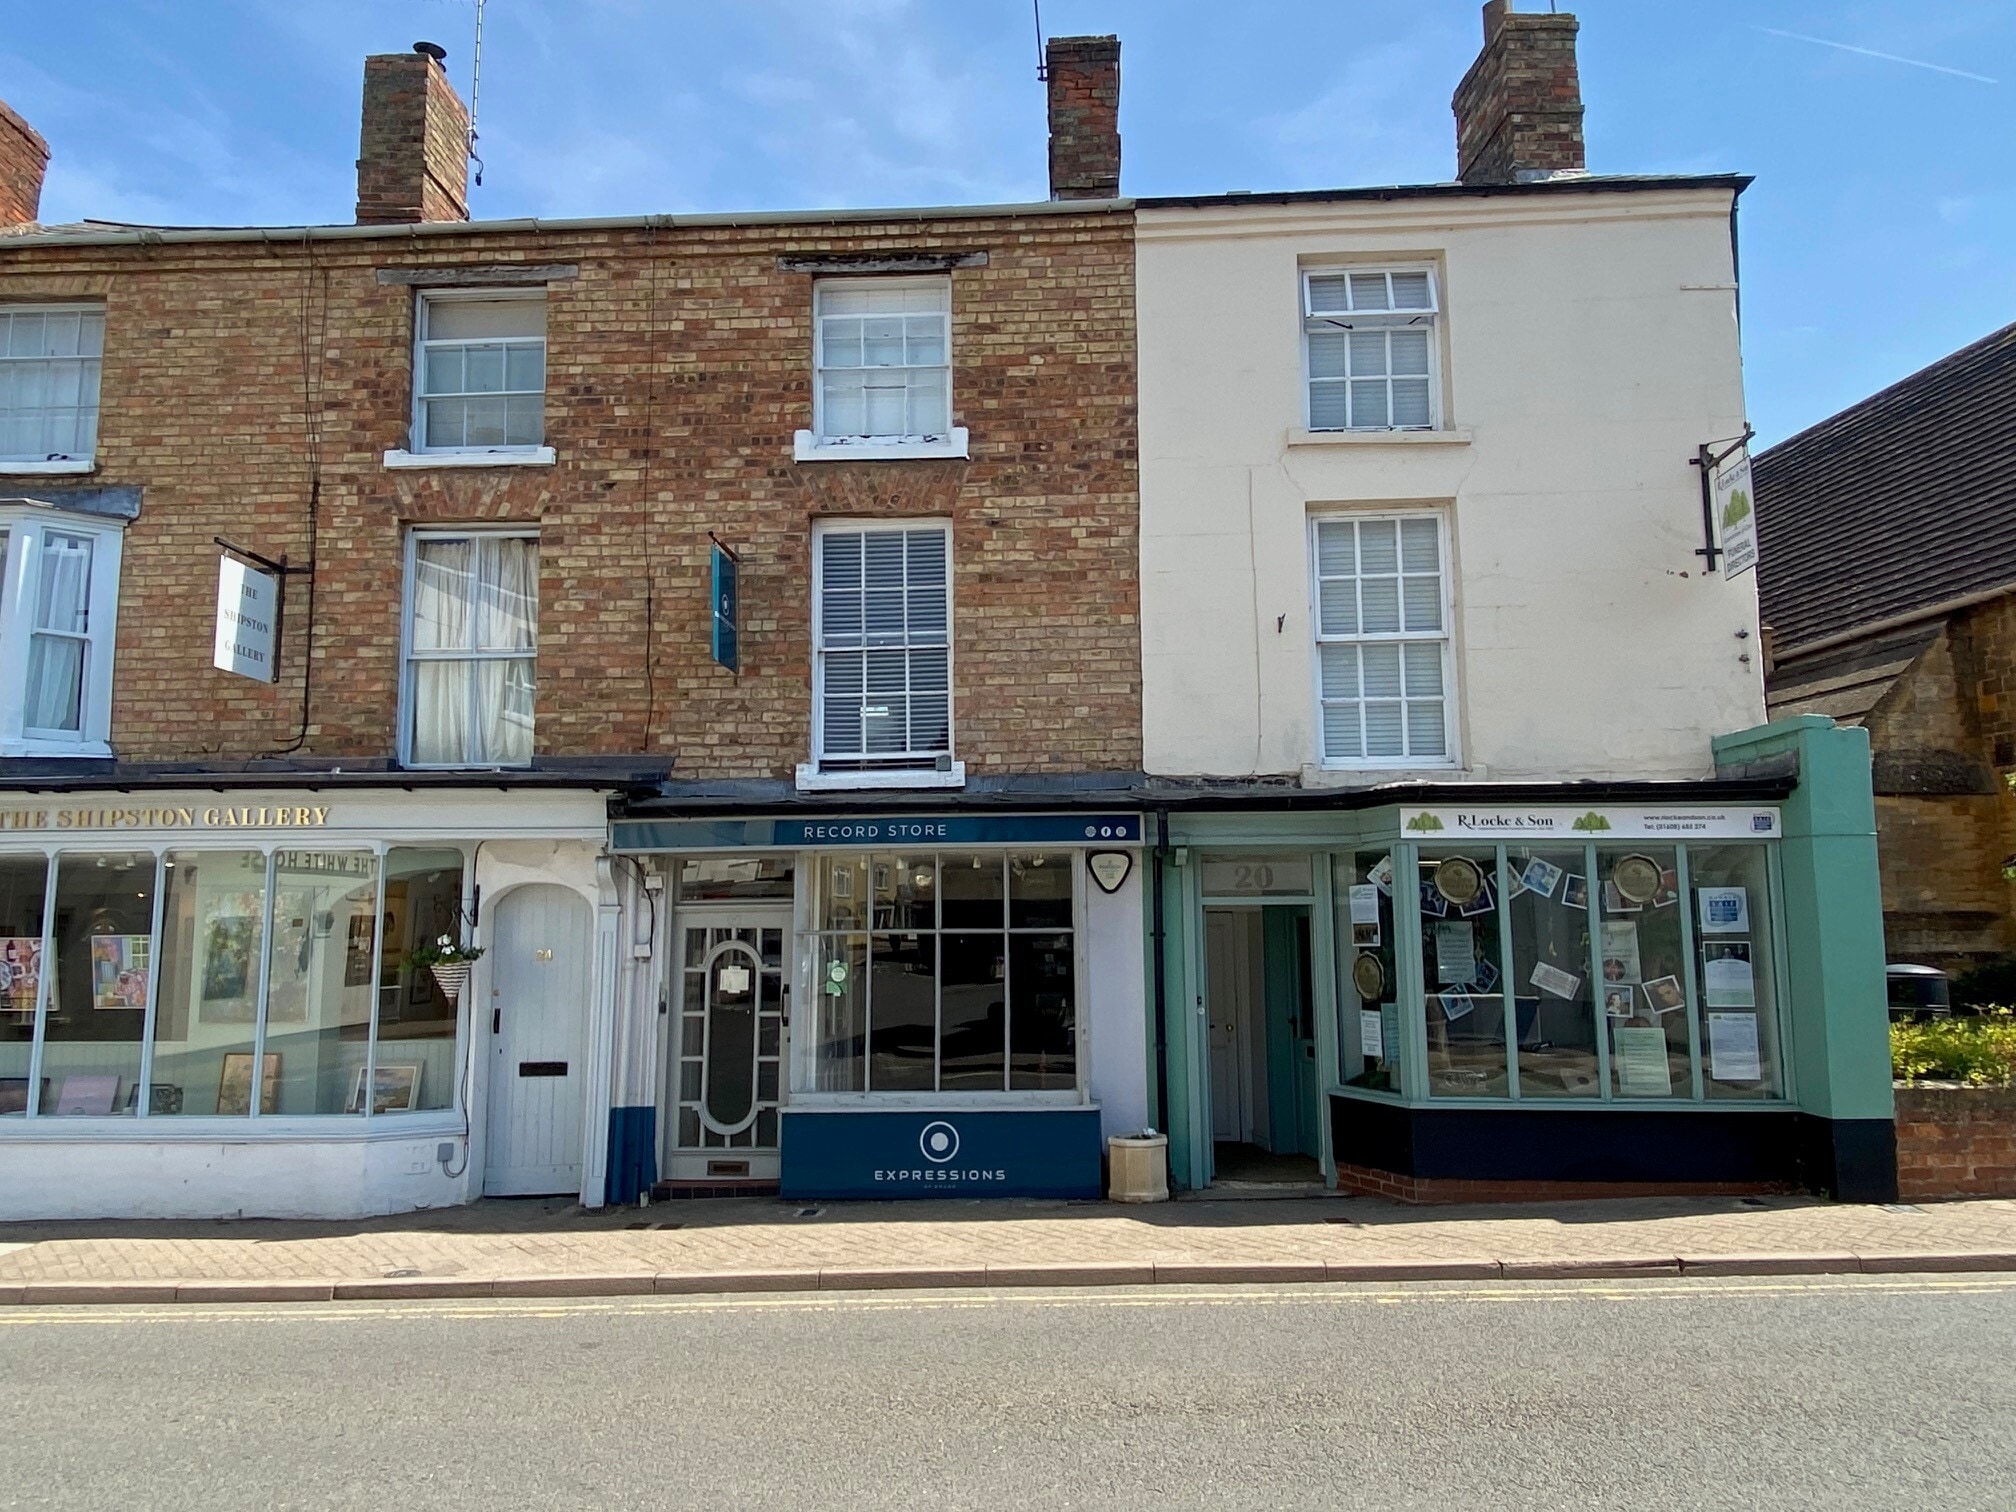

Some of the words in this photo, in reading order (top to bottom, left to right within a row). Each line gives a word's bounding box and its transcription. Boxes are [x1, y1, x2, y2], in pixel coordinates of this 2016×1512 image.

[224, 608, 269, 634] SHIPSTON
[225, 641, 265, 663] GALLERY
[56, 808, 196, 829] SHIPSTON
[204, 806, 331, 827] GALLERY
[1528, 814, 1554, 826] Son
[804, 826, 878, 838] RECORD
[888, 824, 947, 837] STORE
[1235, 865, 1274, 888] 20
[874, 1169, 1006, 1181] EXPRESSIONS
